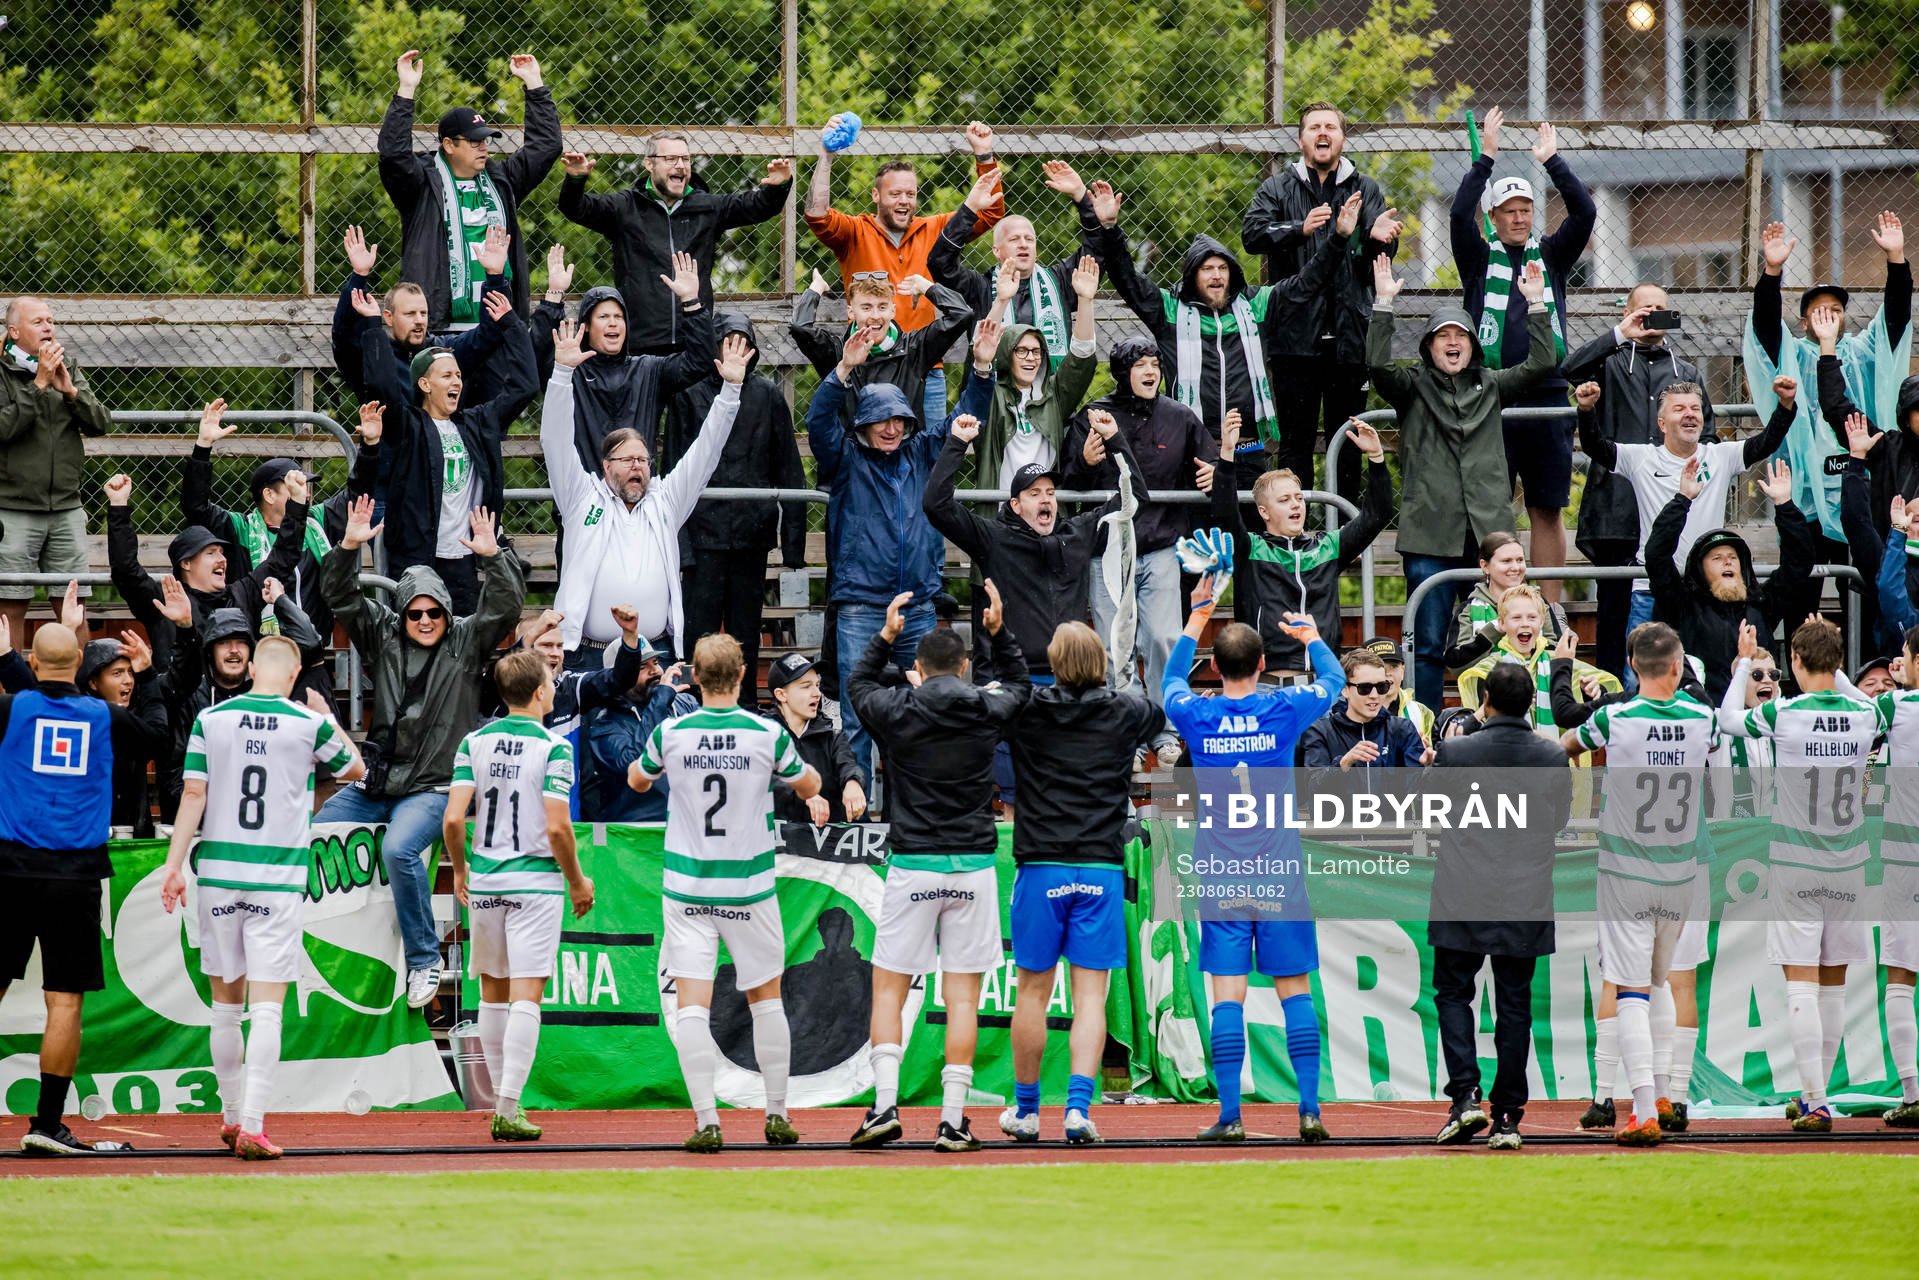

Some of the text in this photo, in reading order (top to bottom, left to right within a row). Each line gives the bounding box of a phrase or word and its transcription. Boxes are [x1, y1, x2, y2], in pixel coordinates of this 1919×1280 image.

[1829, 458, 1850, 471] Nor
[239, 714, 279, 731] ABB
[1217, 715, 1260, 734] ABB
[1811, 716, 1851, 732] ABB
[1646, 725, 1686, 741] ABB
[245, 740, 267, 755] ASK
[697, 734, 737, 751] ABB
[1203, 733, 1276, 754] FAGERSTRÖM
[1805, 742, 1858, 757] HELLBLOM
[683, 754, 751, 770] MAGNUSSON
[1646, 748, 1686, 766] TRONÊT
[238, 765, 267, 830] 8
[1635, 772, 1692, 833] 23
[1803, 765, 1856, 827] 16
[703, 773, 727, 837] 2
[484, 786, 520, 852] 11
[1797, 886, 1857, 903] axelssons
[684, 904, 751, 921] axelssons
